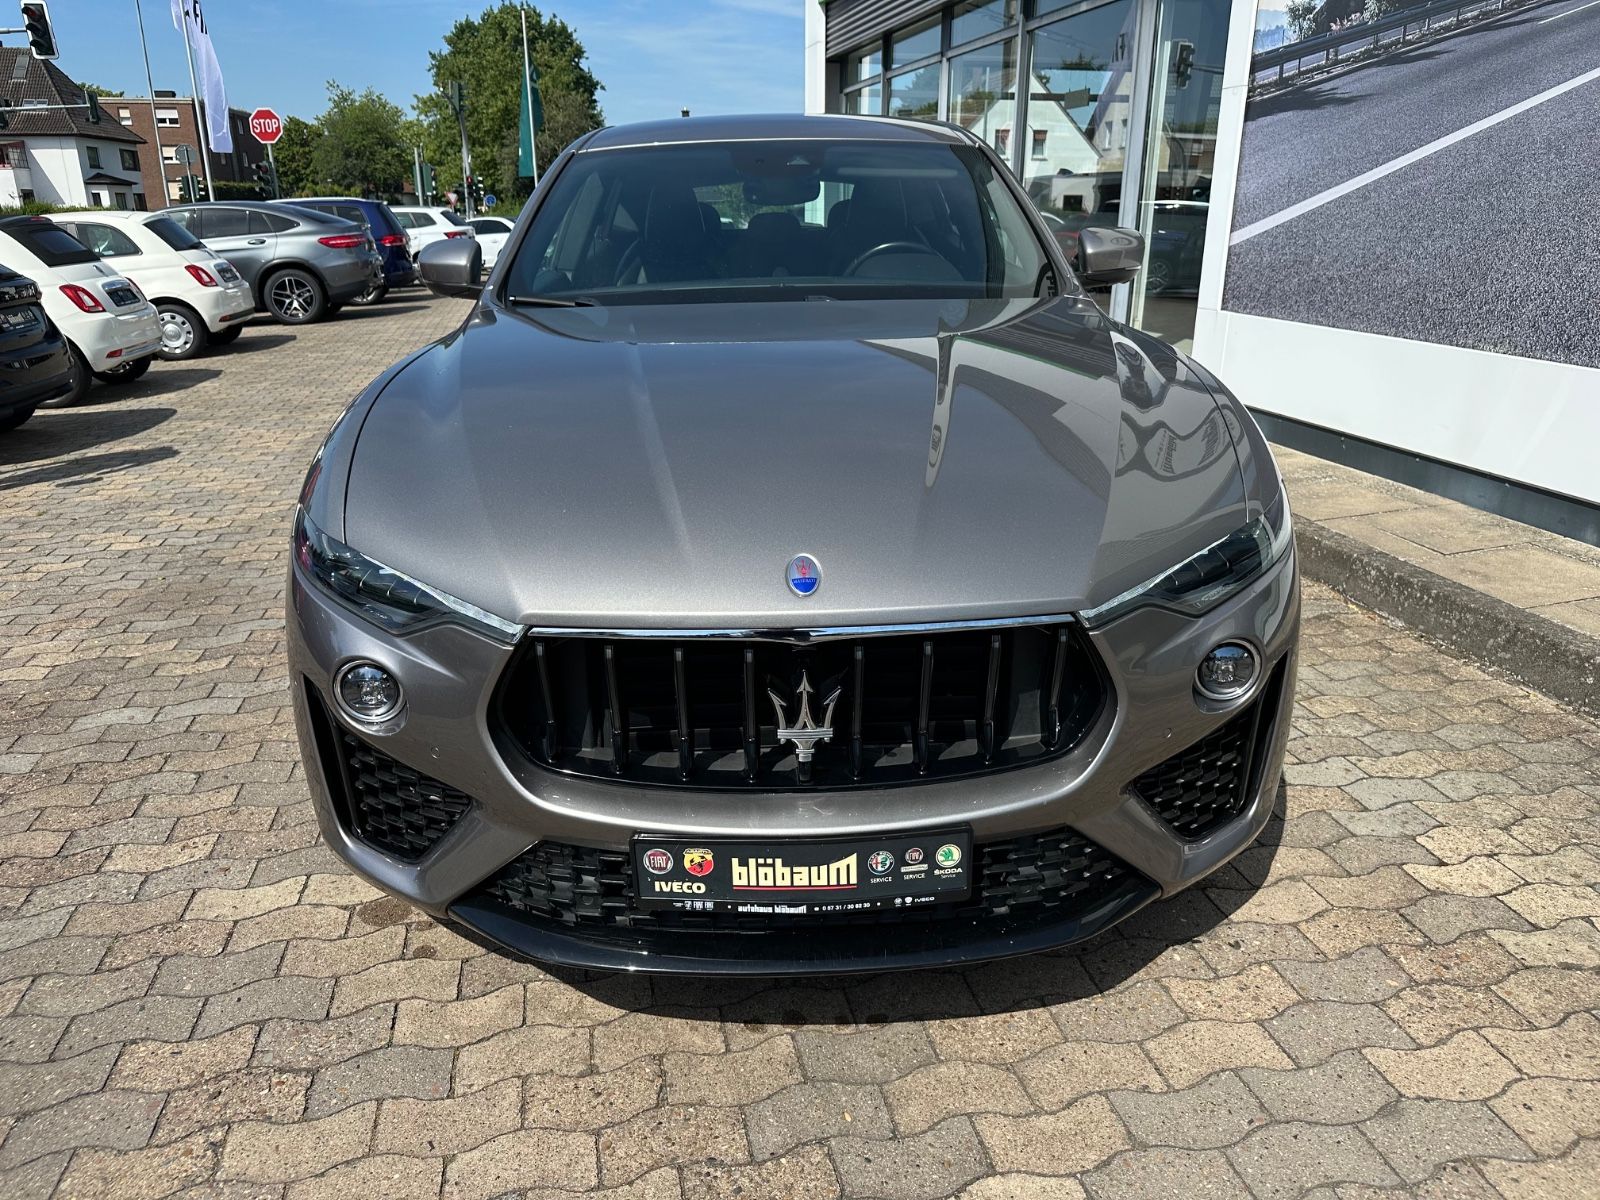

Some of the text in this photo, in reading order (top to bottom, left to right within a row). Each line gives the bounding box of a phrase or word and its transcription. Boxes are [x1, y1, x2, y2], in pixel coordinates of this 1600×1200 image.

[253, 119, 279, 133] STOP
[650, 856, 667, 868] FIAT
[731, 852, 858, 886] blöbaum
[933, 868, 963, 876] ŠKODA
[870, 876, 893, 884] SERVICE
[654, 881, 707, 894] IVECO
[737, 904, 773, 913] autohaus
